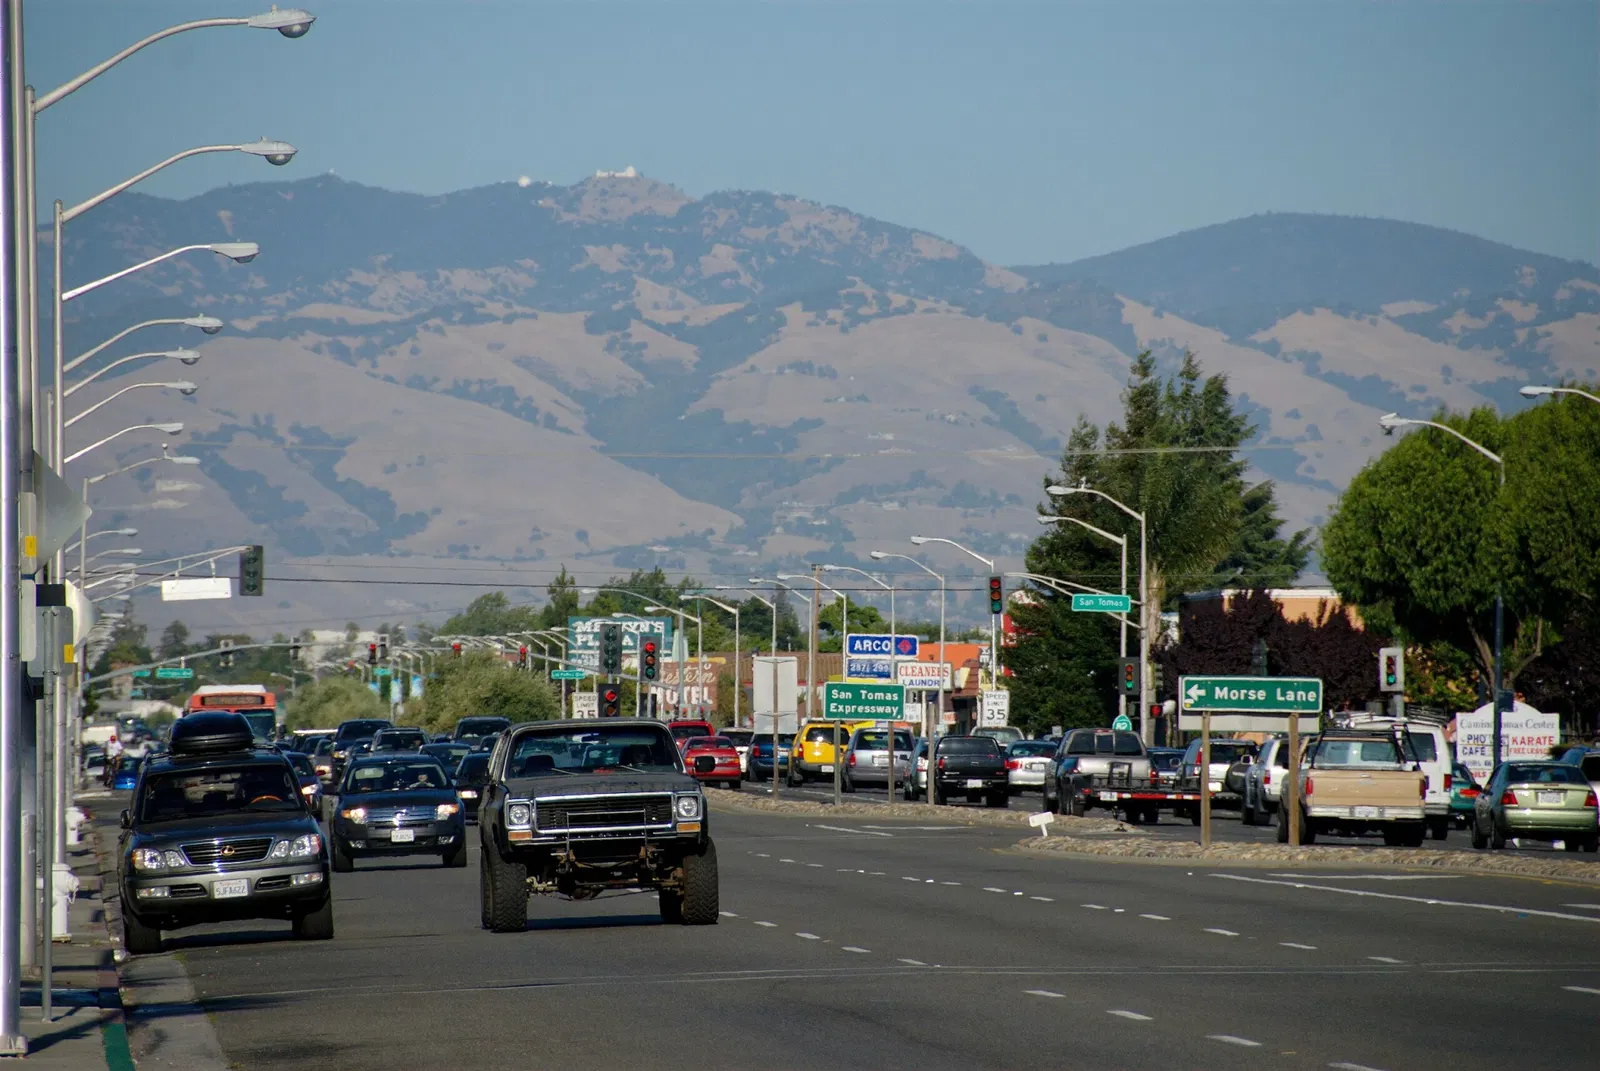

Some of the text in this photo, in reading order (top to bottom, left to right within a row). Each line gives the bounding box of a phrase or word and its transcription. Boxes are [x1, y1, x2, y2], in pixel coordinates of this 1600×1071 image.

[1079, 598, 1123, 607] San Tomas
[575, 634, 634, 646] PLA
[854, 639, 891, 651] ARCO
[831, 689, 898, 701] San Tomas
[1214, 687, 1317, 702] Morse Lane
[830, 703, 899, 716] Expressway
[986, 709, 1006, 720] 35
[1525, 718, 1555, 729] Center
[1512, 736, 1555, 746] KARATE
